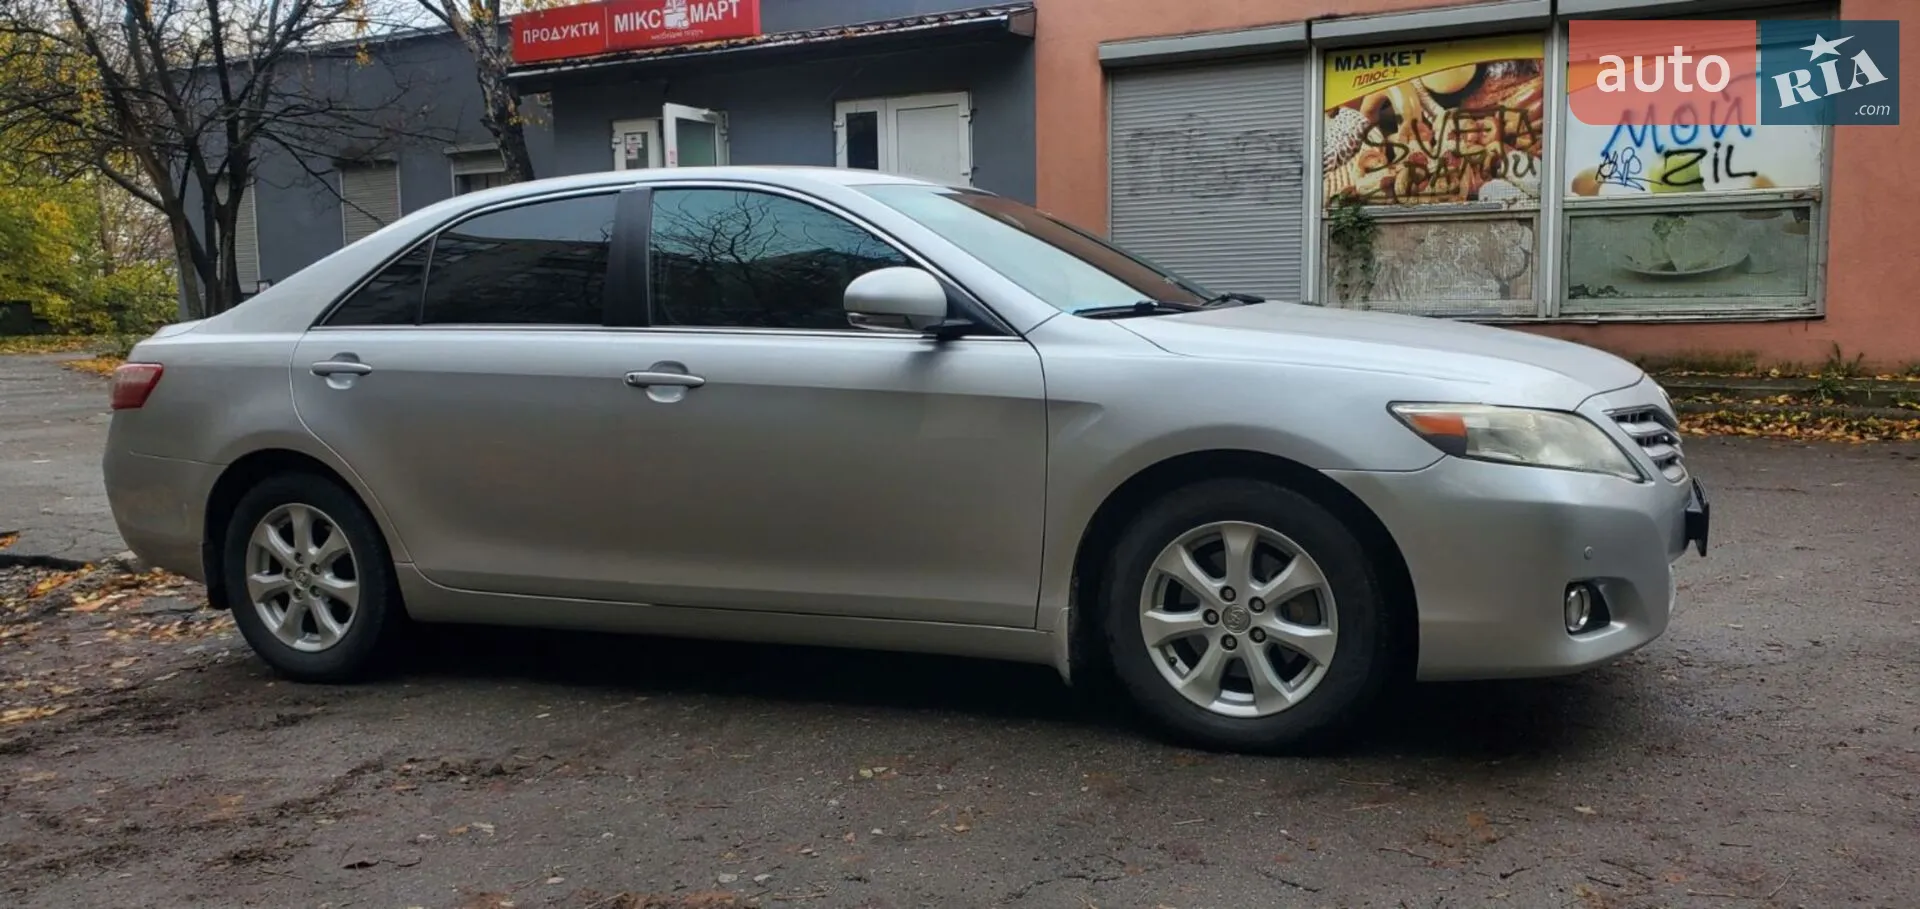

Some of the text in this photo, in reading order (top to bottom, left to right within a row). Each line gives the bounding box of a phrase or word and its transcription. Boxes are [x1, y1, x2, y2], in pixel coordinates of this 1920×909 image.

[614, 0, 741, 34] МІКС МАРТ
[523, 21, 600, 44] ПРОДУКТИ
[1335, 49, 1426, 72] МАРКЕТ
